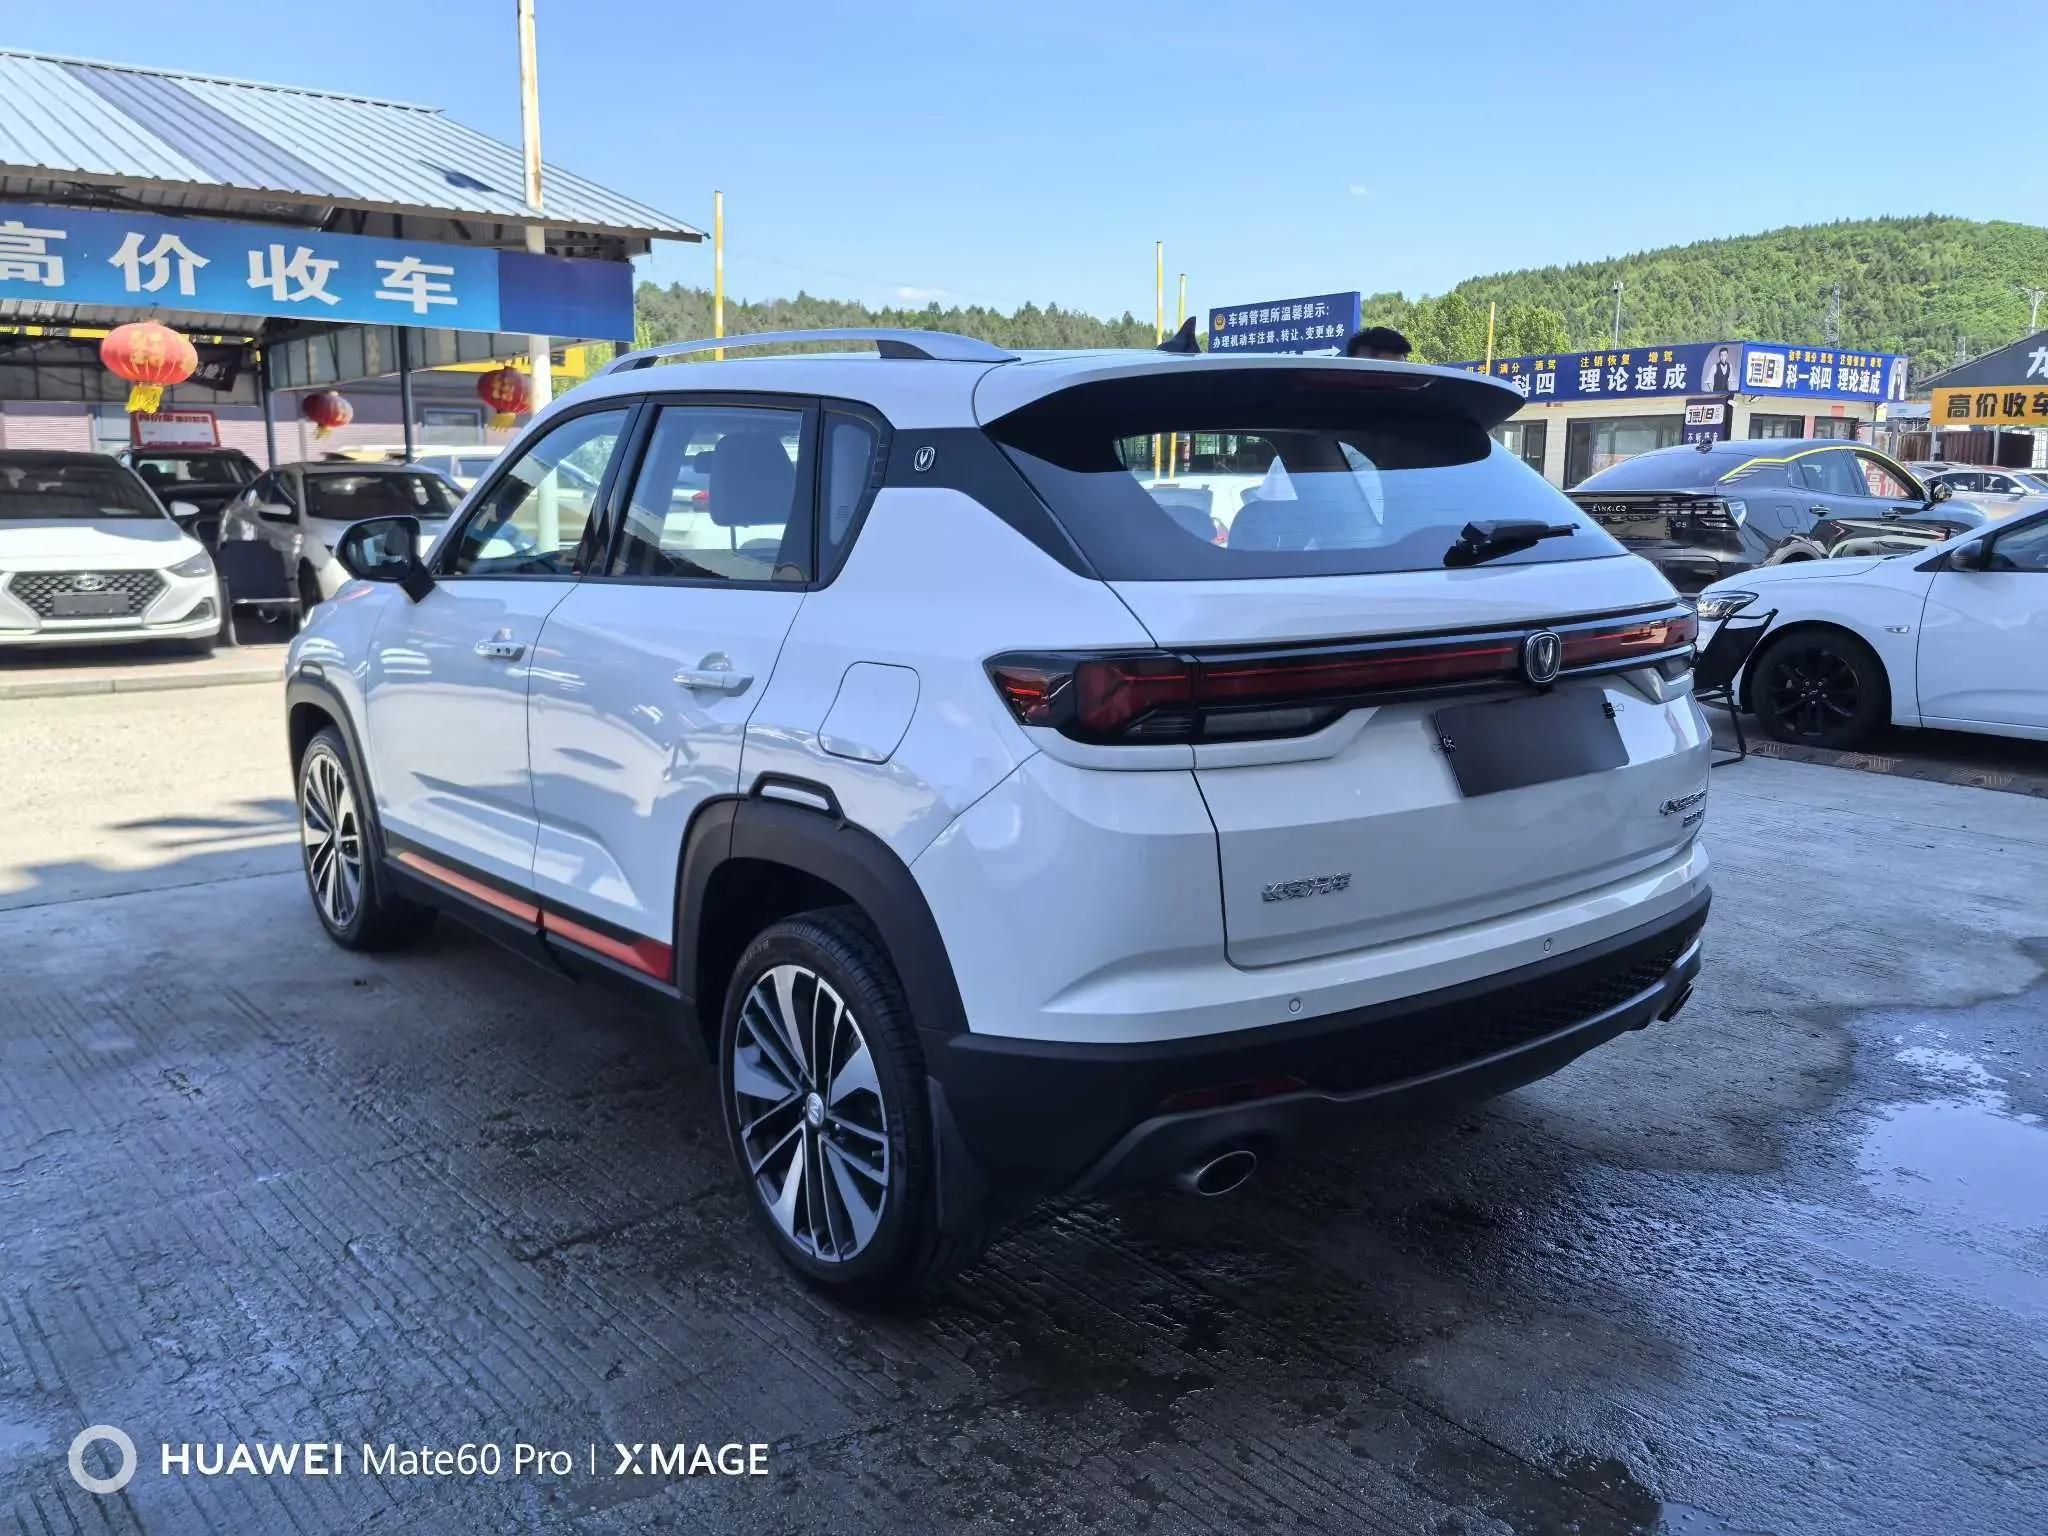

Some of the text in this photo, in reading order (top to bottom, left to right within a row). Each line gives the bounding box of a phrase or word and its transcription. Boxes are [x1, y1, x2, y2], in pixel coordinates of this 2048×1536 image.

[0, 221, 458, 313] 高价收车
[1579, 363, 1687, 392] 理论速成
[1785, 363, 1881, 395] 科一科四 理论速成
[1947, 391, 2048, 419] 高价收车
